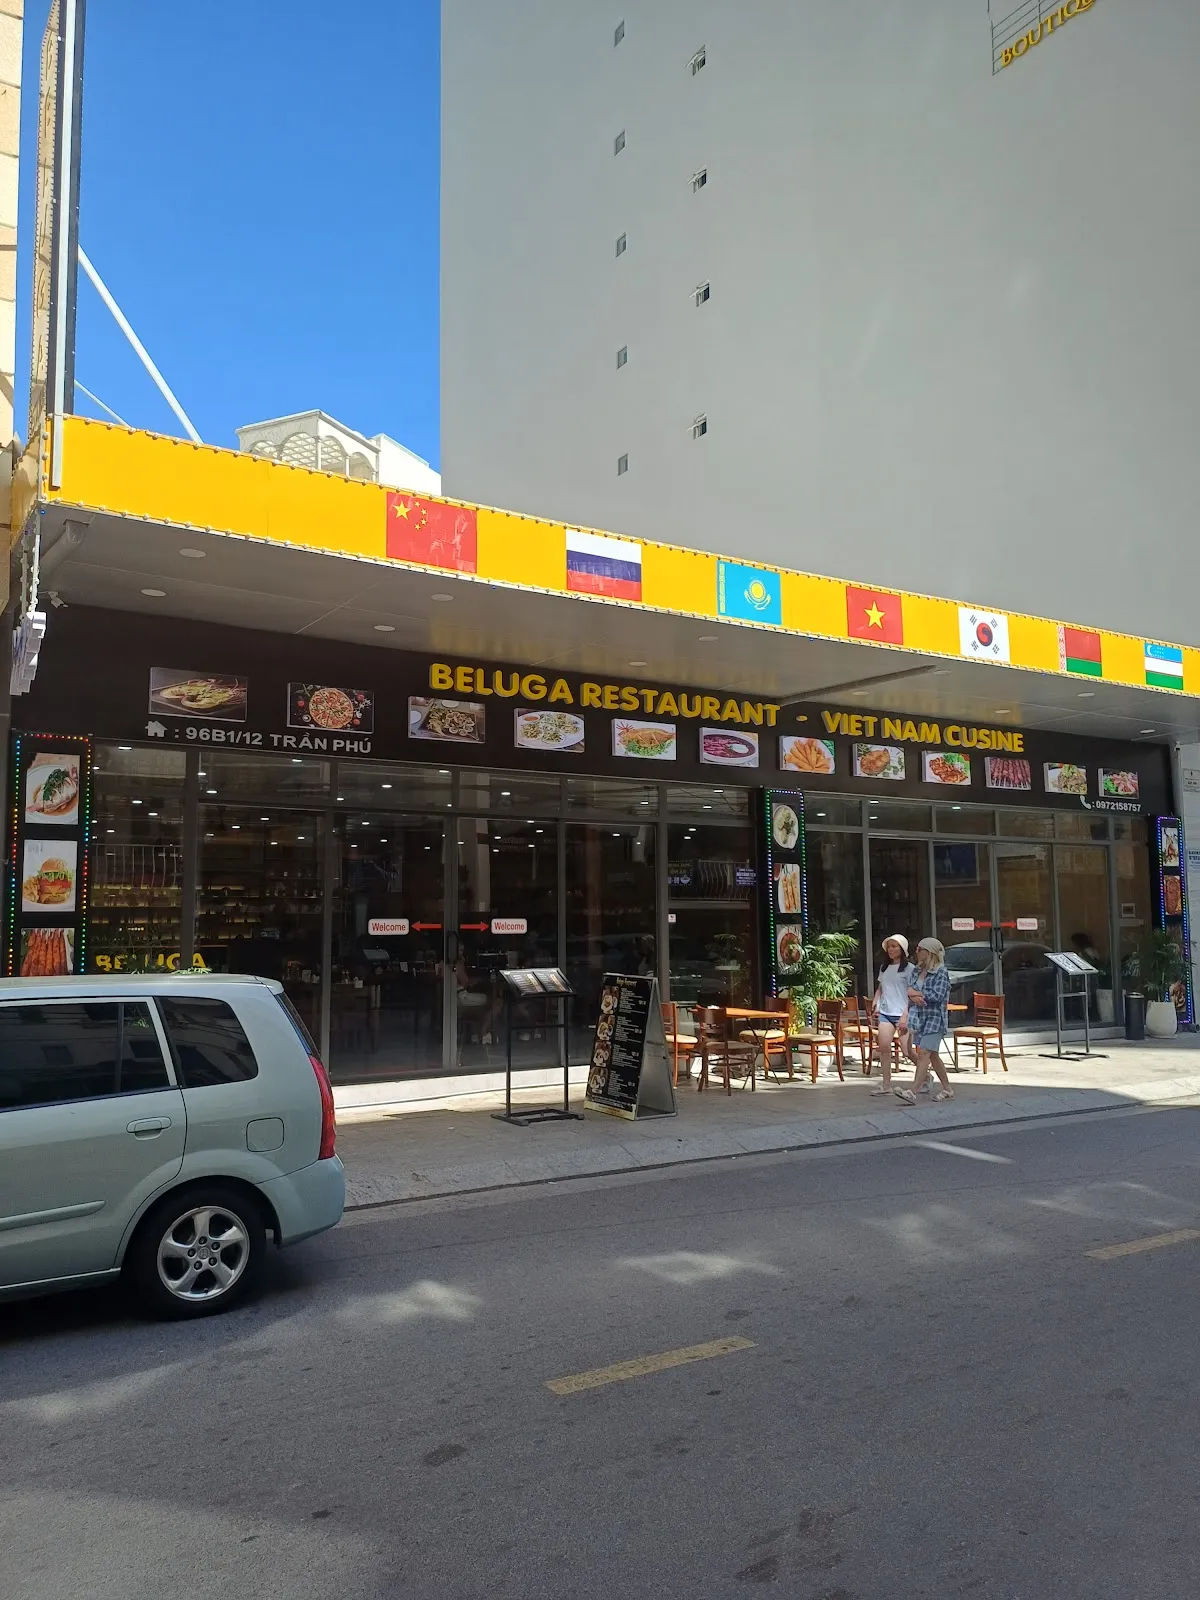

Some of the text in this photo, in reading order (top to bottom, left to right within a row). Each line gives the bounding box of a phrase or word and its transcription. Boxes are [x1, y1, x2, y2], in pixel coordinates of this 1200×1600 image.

[429, 662, 574, 705] BELUGA
[580, 683, 781, 727] RESTAURANT
[822, 710, 879, 736] VIET
[880, 717, 942, 745] NAM
[943, 724, 1025, 753] CUSINE
[185, 726, 263, 746] 96B1/12
[332, 738, 372, 753] PHÚ
[371, 922, 407, 932] Welcome
[494, 921, 525, 931] Welcome
